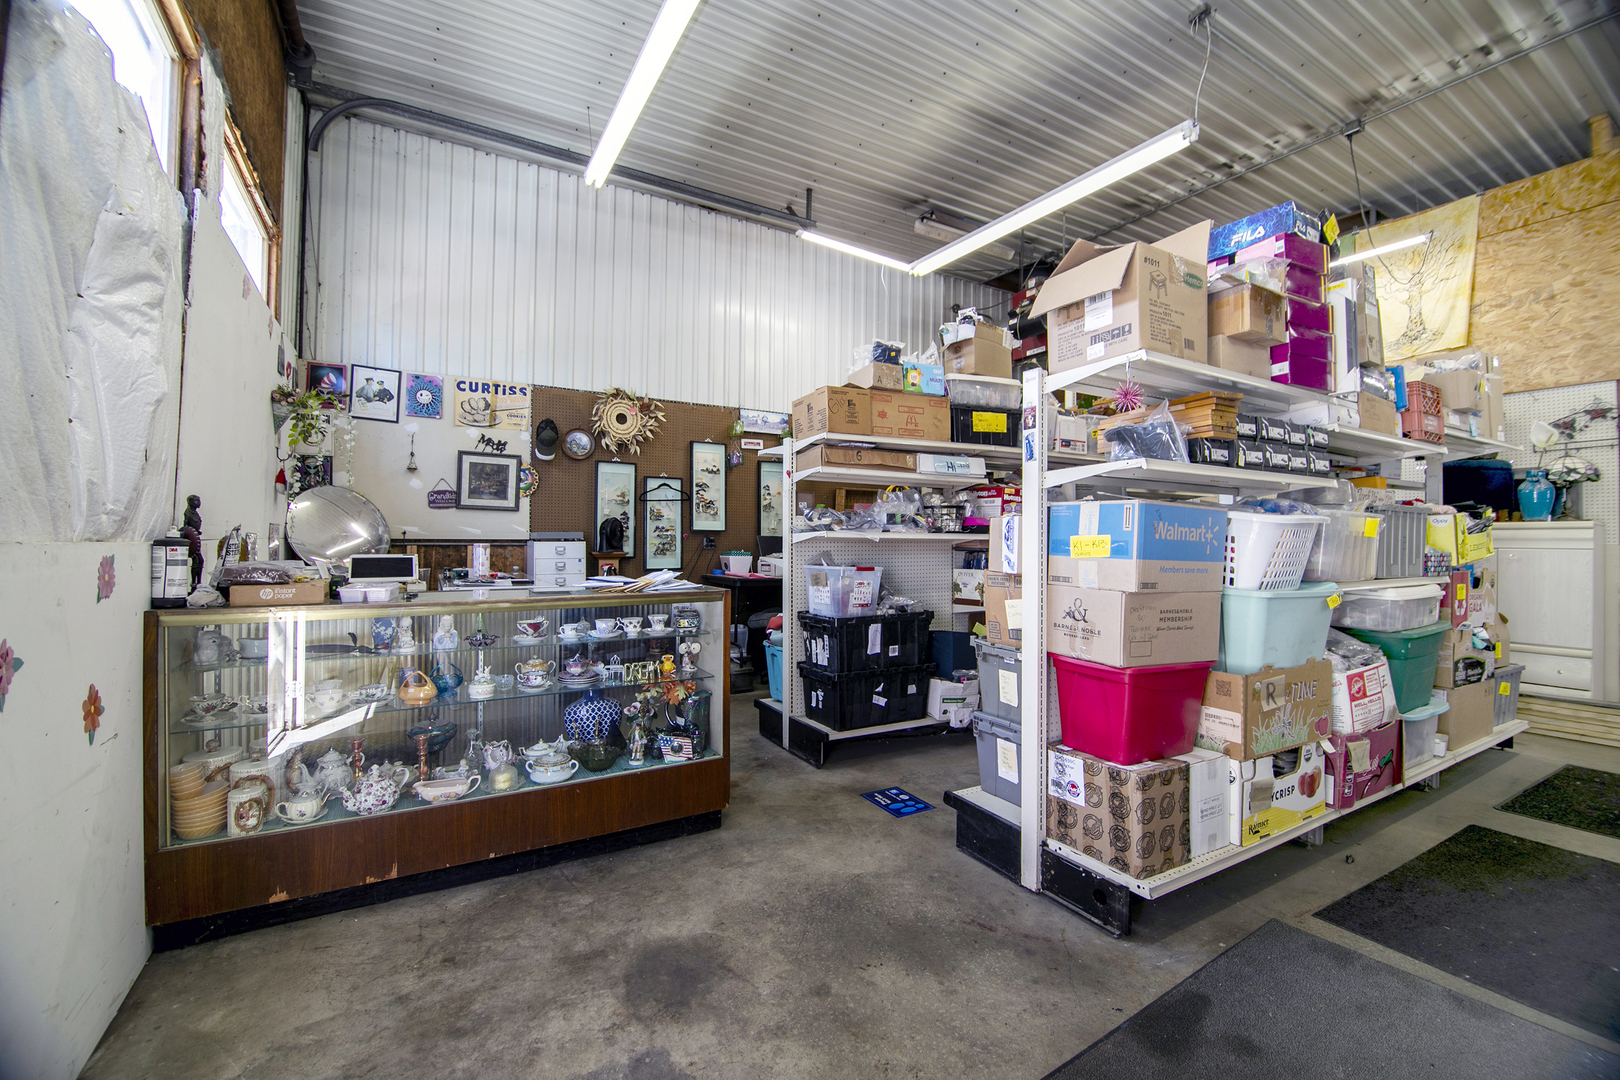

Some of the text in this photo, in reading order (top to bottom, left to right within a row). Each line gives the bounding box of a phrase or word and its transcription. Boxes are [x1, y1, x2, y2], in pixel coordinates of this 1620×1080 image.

[1295, 220, 1306, 232] FILA
[1230, 226, 1266, 246] FILA
[1144, 256, 1160, 268] #1011
[877, 376, 882, 384] A
[1154, 521, 1206, 542] Walmart
[260, 588, 273, 600] hp
[1469, 603, 1482, 612] GALA
[1053, 622, 1101, 636] BARNES NOBLE
[1266, 682, 1278, 706] R
[1292, 680, 1317, 703] TIME
